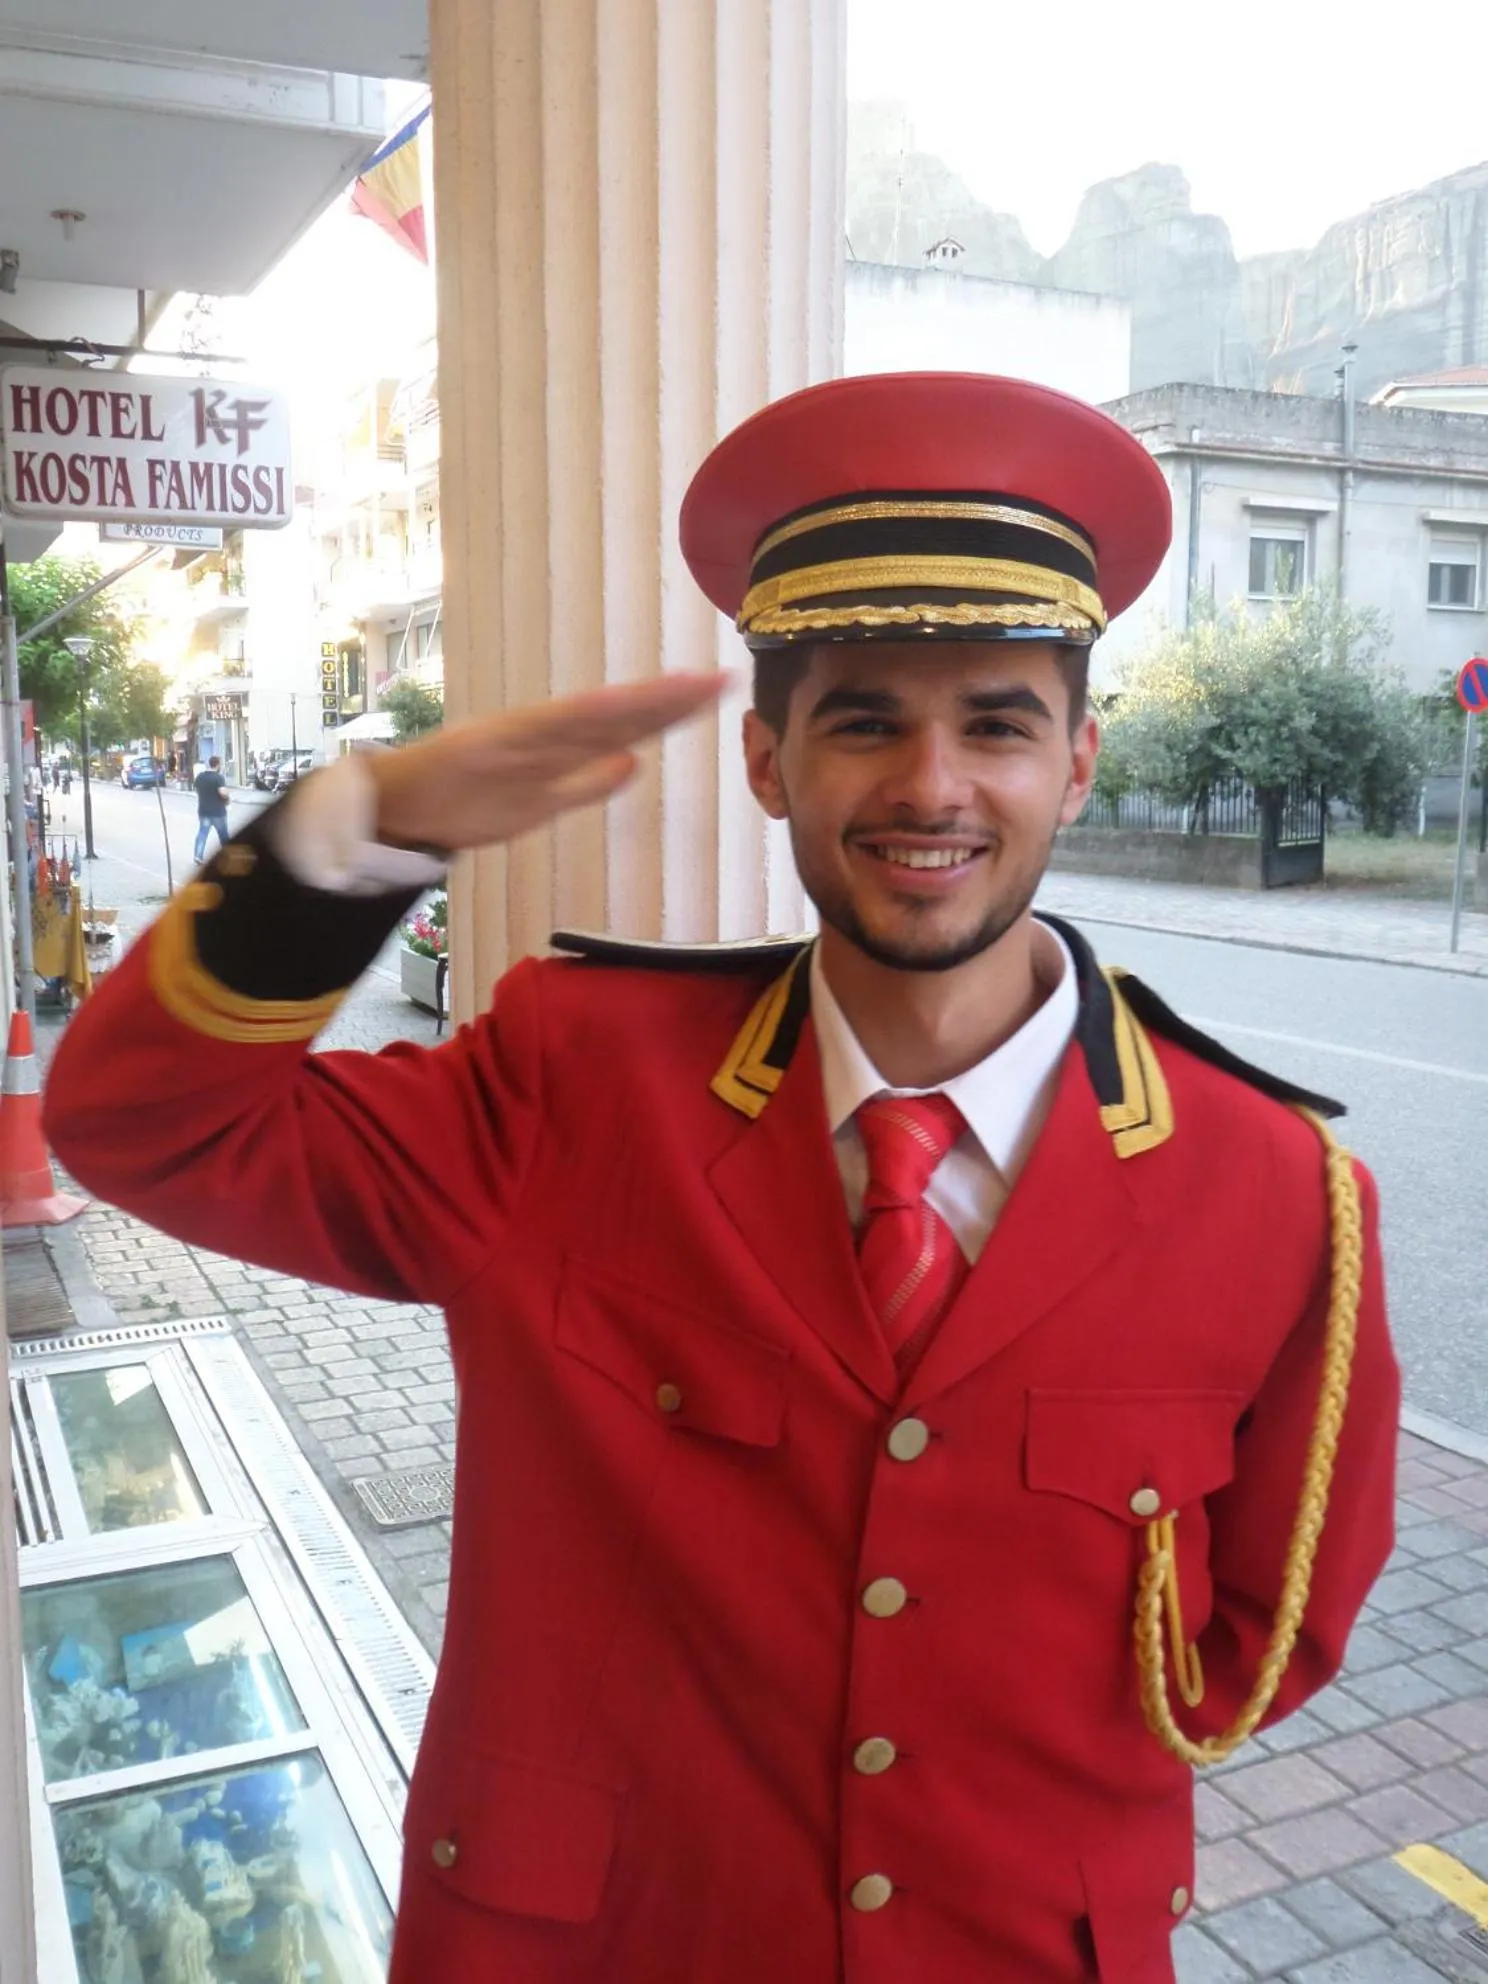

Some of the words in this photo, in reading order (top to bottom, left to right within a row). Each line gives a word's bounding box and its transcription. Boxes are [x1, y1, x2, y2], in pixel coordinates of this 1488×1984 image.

[10, 384, 166, 442] HOTEL
[188, 386, 275, 458] KF
[13, 450, 136, 508] KOSTA
[146, 458, 286, 515] FAMISSI
[123, 523, 204, 541] PRODUCTS
[207, 702, 240, 712] HOTEL
[322, 643, 337, 725] HOTEL
